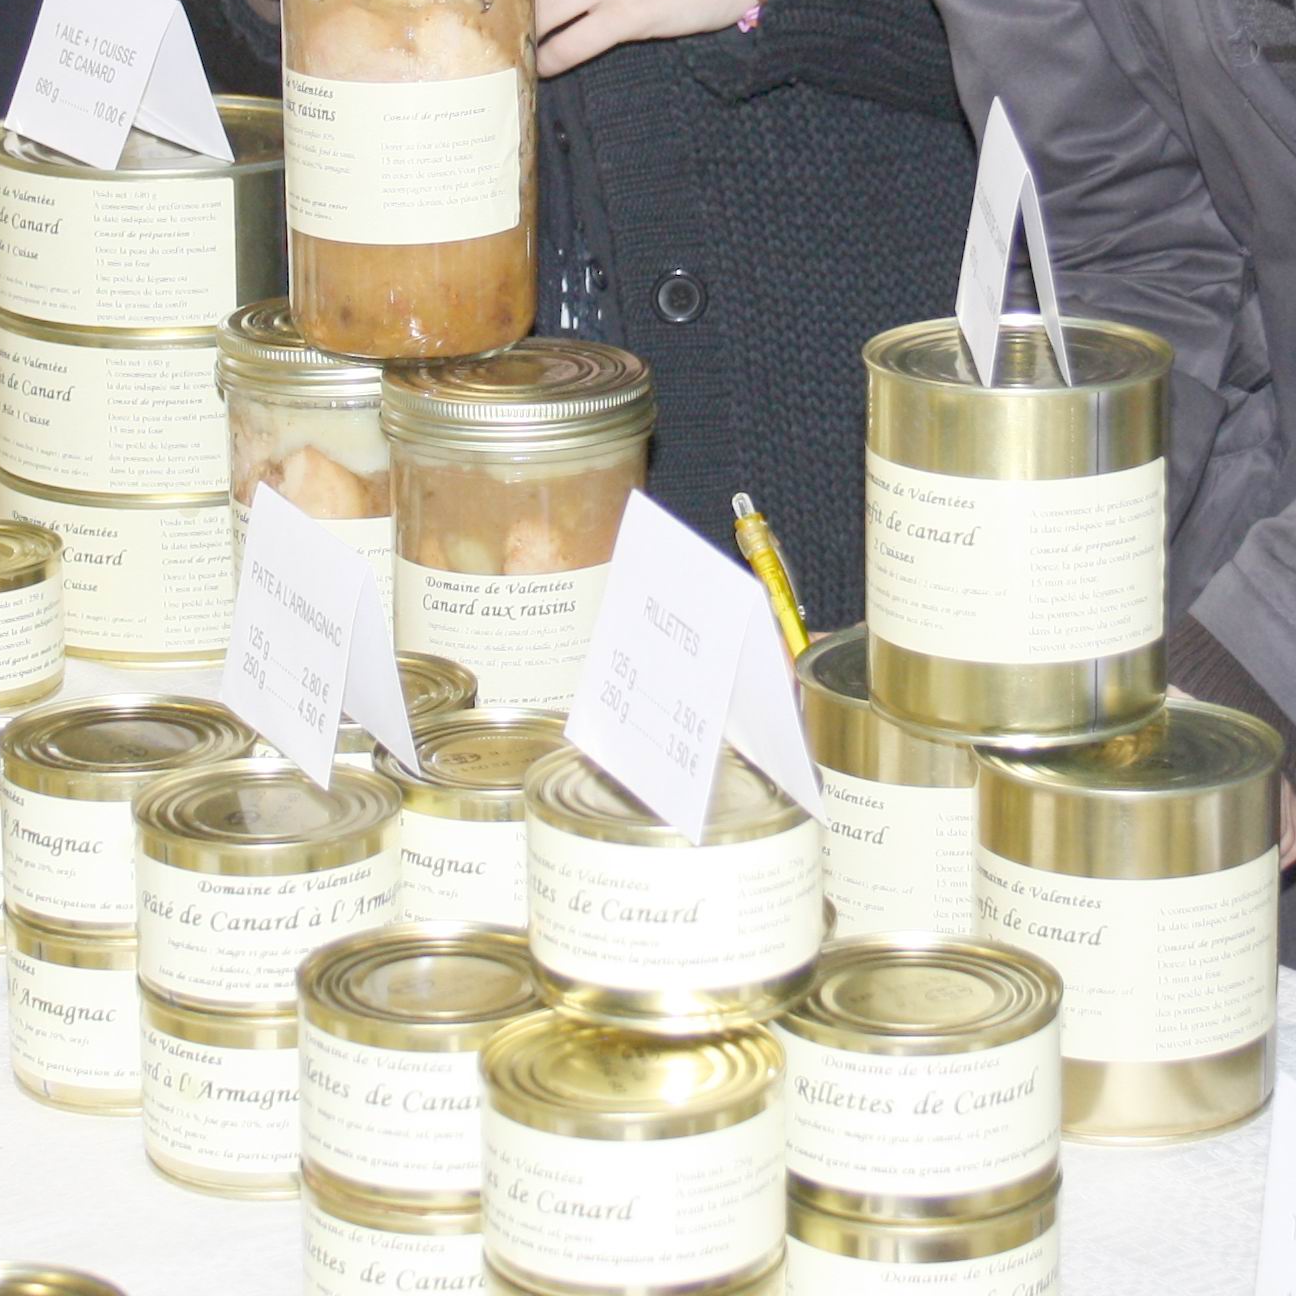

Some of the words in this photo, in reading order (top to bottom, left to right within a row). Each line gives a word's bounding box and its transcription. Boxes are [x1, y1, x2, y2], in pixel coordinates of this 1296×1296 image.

[60, 27, 84, 47] AILE
[100, 39, 137, 67] CUISSE
[58, 48, 73, 66] DE
[73, 53, 116, 84] CANARD
[92, 100, 118, 124] 10.00
[118, 110, 128, 127] €
[298, 102, 336, 122] raisins
[63, 521, 119, 539] Valentées
[885, 513, 902, 533] de
[906, 519, 982, 548] canard
[63, 545, 128, 569] Canard
[64, 578, 98, 593] Cuisse
[424, 574, 481, 595] Domaine
[484, 579, 501, 596] de
[504, 577, 575, 596] Valentées
[251, 559, 278, 597] PATE
[282, 585, 343, 649] L'ARMAGNAC
[422, 593, 476, 617] Canard
[481, 602, 517, 621] aux
[519, 597, 576, 616] raisins
[642, 595, 702, 659] RILLETTES
[247, 623, 263, 653] 125
[261, 641, 271, 661] g
[301, 666, 322, 698] 2.80
[320, 684, 330, 706] €
[241, 652, 257, 682] 250
[256, 671, 266, 690] g
[297, 696, 318, 728] 4.50
[317, 713, 325, 735] €
[609, 648, 632, 681] 125
[627, 668, 639, 692] g
[672, 698, 696, 734] 2.50
[695, 717, 707, 744] €
[599, 679, 620, 715] 250
[618, 703, 630, 725] g
[664, 732, 689, 768] 3.50
[688, 752, 700, 779] €
[10, 818, 104, 857] Armagnac
[197, 878, 273, 897] Domaine
[277, 880, 297, 895] de
[304, 866, 373, 893] Valentées
[568, 889, 592, 916] de
[601, 897, 707, 925] Canard
[1002, 905, 1022, 931] de
[1027, 916, 1109, 947] canard
[156, 1039, 224, 1067] Valentées
[820, 1053, 894, 1076] Domaine
[899, 1061, 919, 1076] de
[924, 1053, 1002, 1078] Valentées
[793, 1075, 895, 1116] Rillettes
[913, 1091, 945, 1116] de
[953, 1067, 1039, 1116] Canard
[507, 1178, 531, 1204] de
[536, 1189, 641, 1223] Canard
